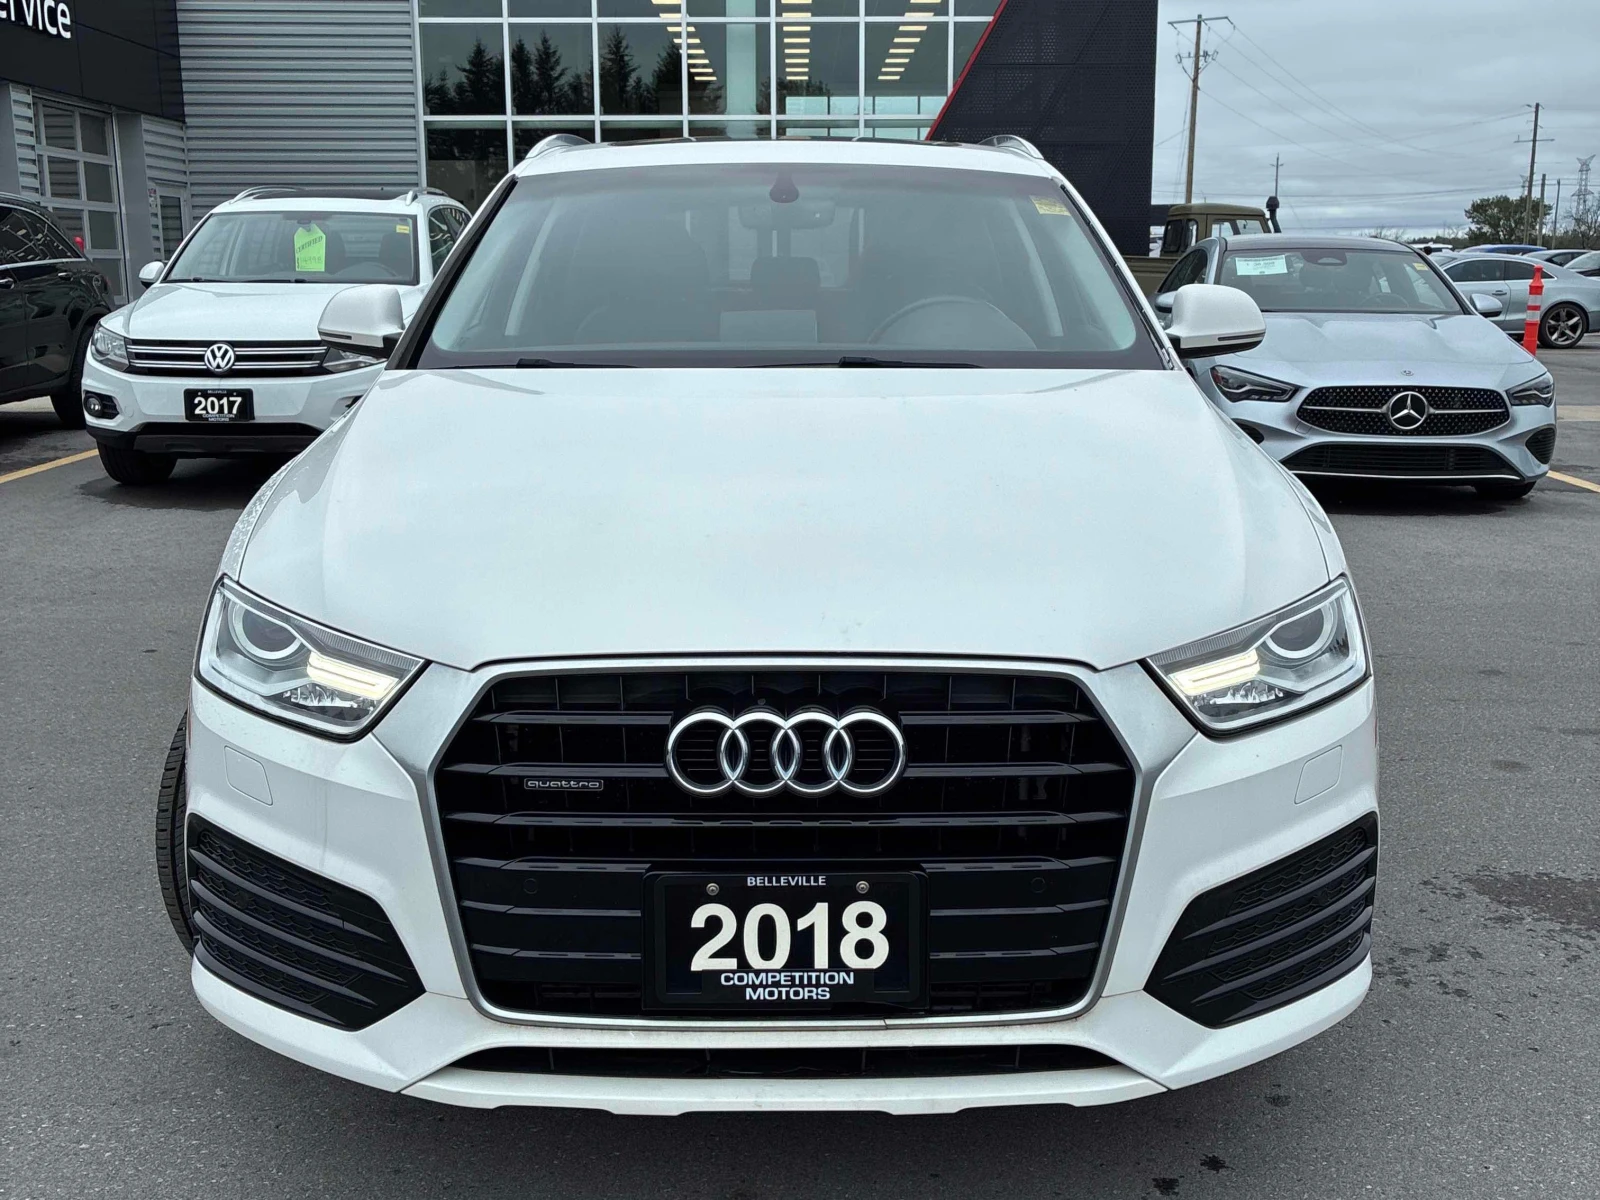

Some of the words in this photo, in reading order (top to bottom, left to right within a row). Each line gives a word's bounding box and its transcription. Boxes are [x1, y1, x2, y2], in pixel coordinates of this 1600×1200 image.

[296, 235, 323, 254] CERTIFIED
[194, 396, 242, 415] 2017
[527, 780, 600, 788] quattro
[747, 875, 827, 887] BELLEVILLE
[690, 900, 890, 971] 2018
[720, 971, 855, 985] COMPETITION
[745, 986, 831, 1000] MOTORS
